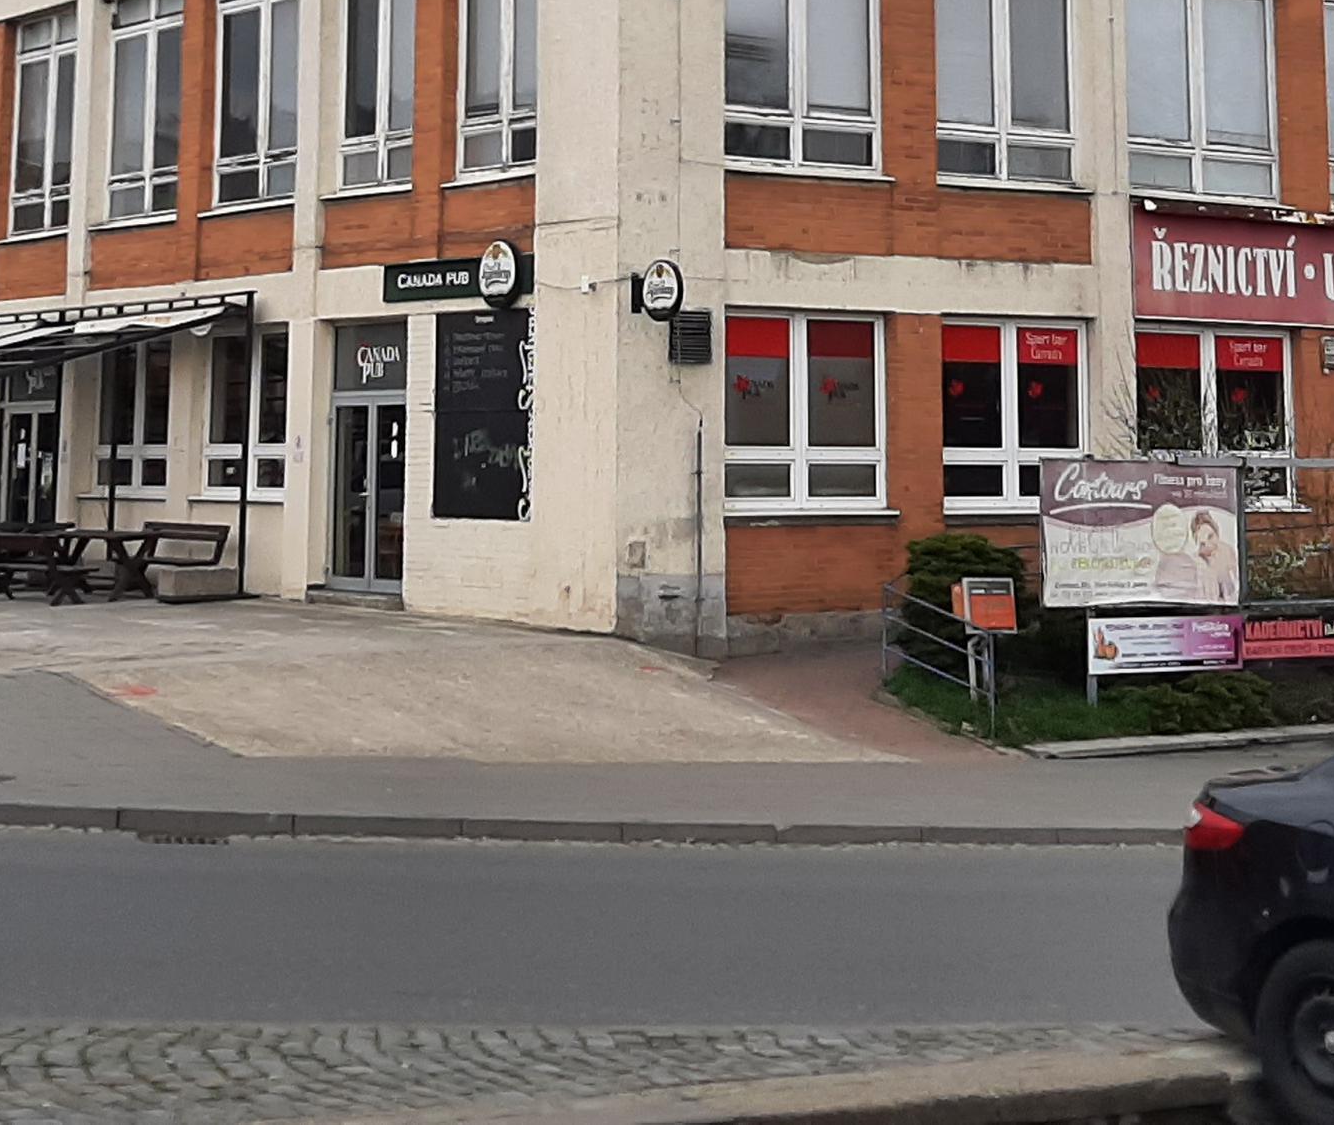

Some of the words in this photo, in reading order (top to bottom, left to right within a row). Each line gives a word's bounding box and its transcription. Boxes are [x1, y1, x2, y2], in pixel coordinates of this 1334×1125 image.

[1151, 226, 1297, 298] ŘEZNICTVÍ
[397, 273, 443, 289] CANADA
[445, 271, 470, 285] PUB
[357, 346, 401, 367] CANADA
[362, 362, 384, 384] PUB
